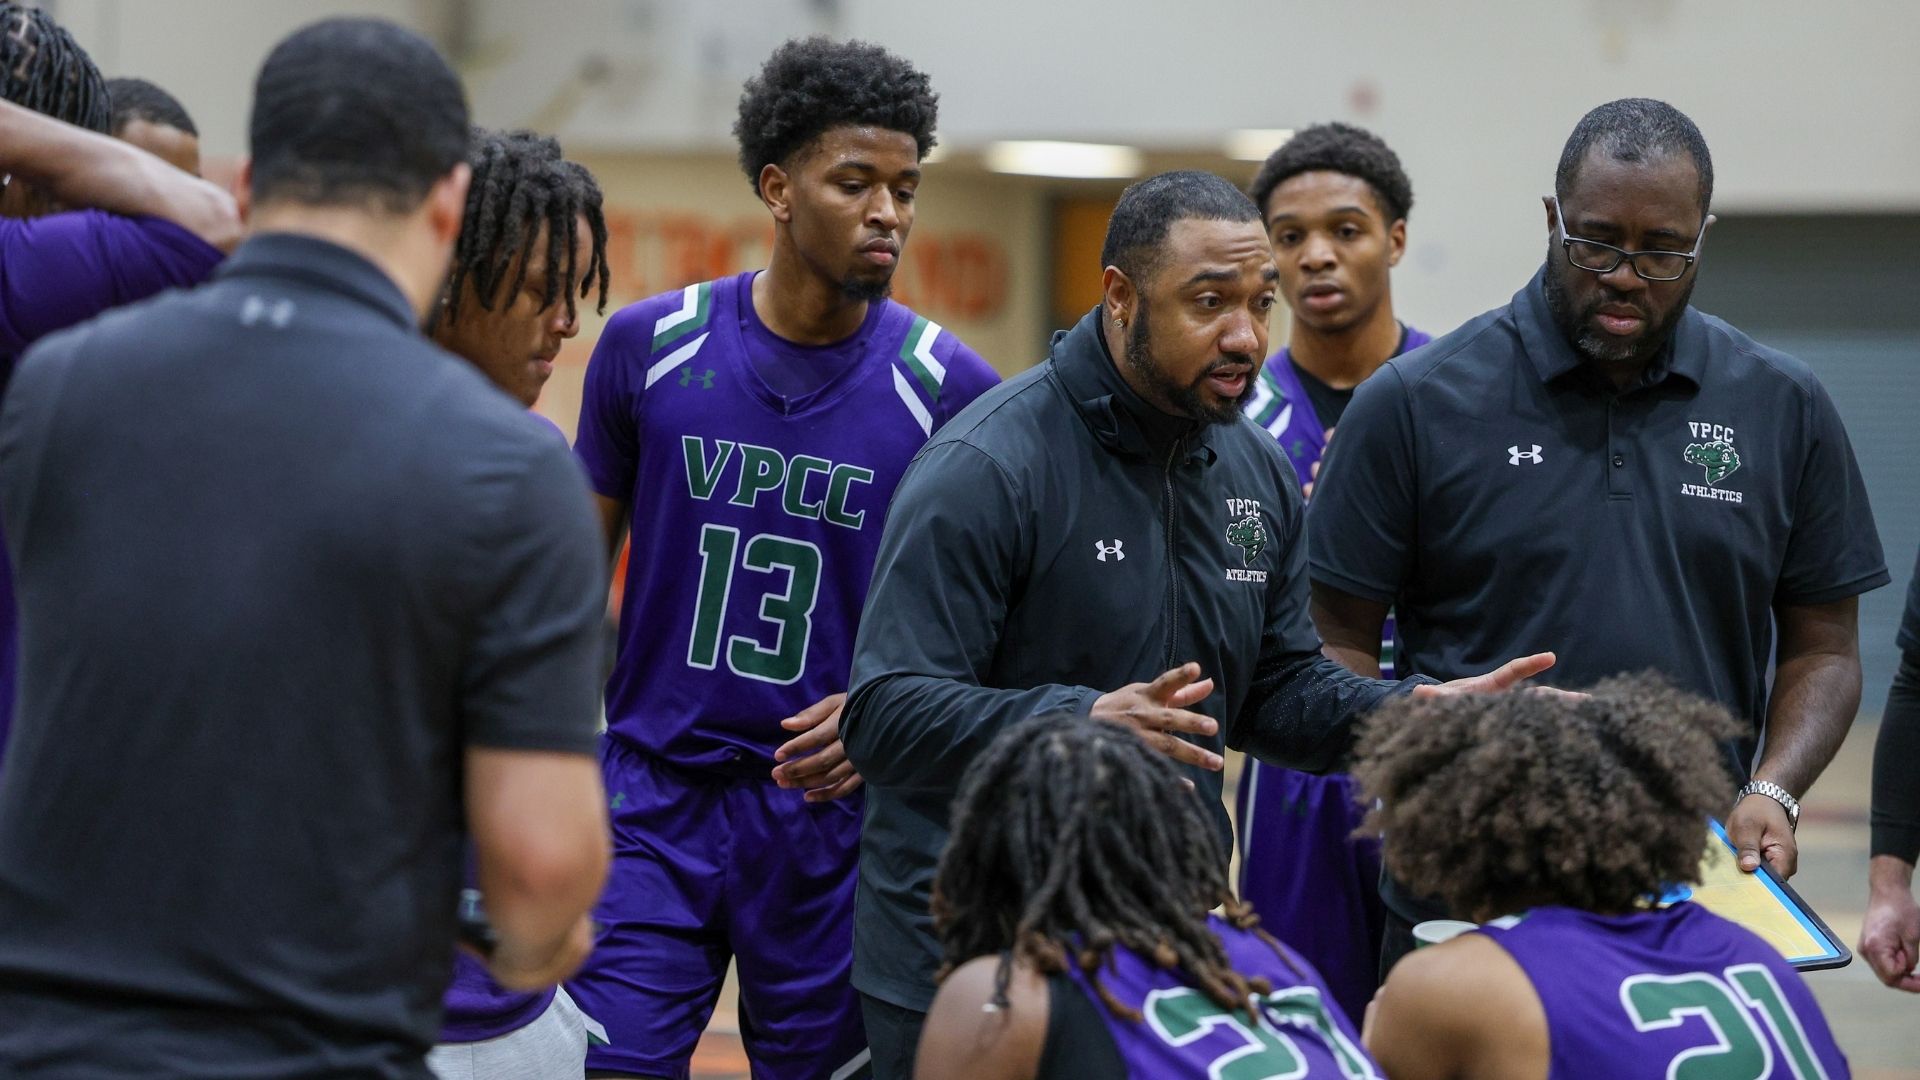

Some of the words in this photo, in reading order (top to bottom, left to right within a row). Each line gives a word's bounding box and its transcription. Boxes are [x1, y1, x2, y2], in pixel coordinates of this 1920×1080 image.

[1688, 421, 1735, 444] VPCC
[681, 435, 875, 531] VPCC
[1680, 483, 1743, 504] ATHLETICS
[1225, 498, 1261, 518] VPCC
[1225, 568, 1268, 583] ATHLETICS
[686, 522, 823, 686] 13
[1618, 962, 1832, 1080] 21
